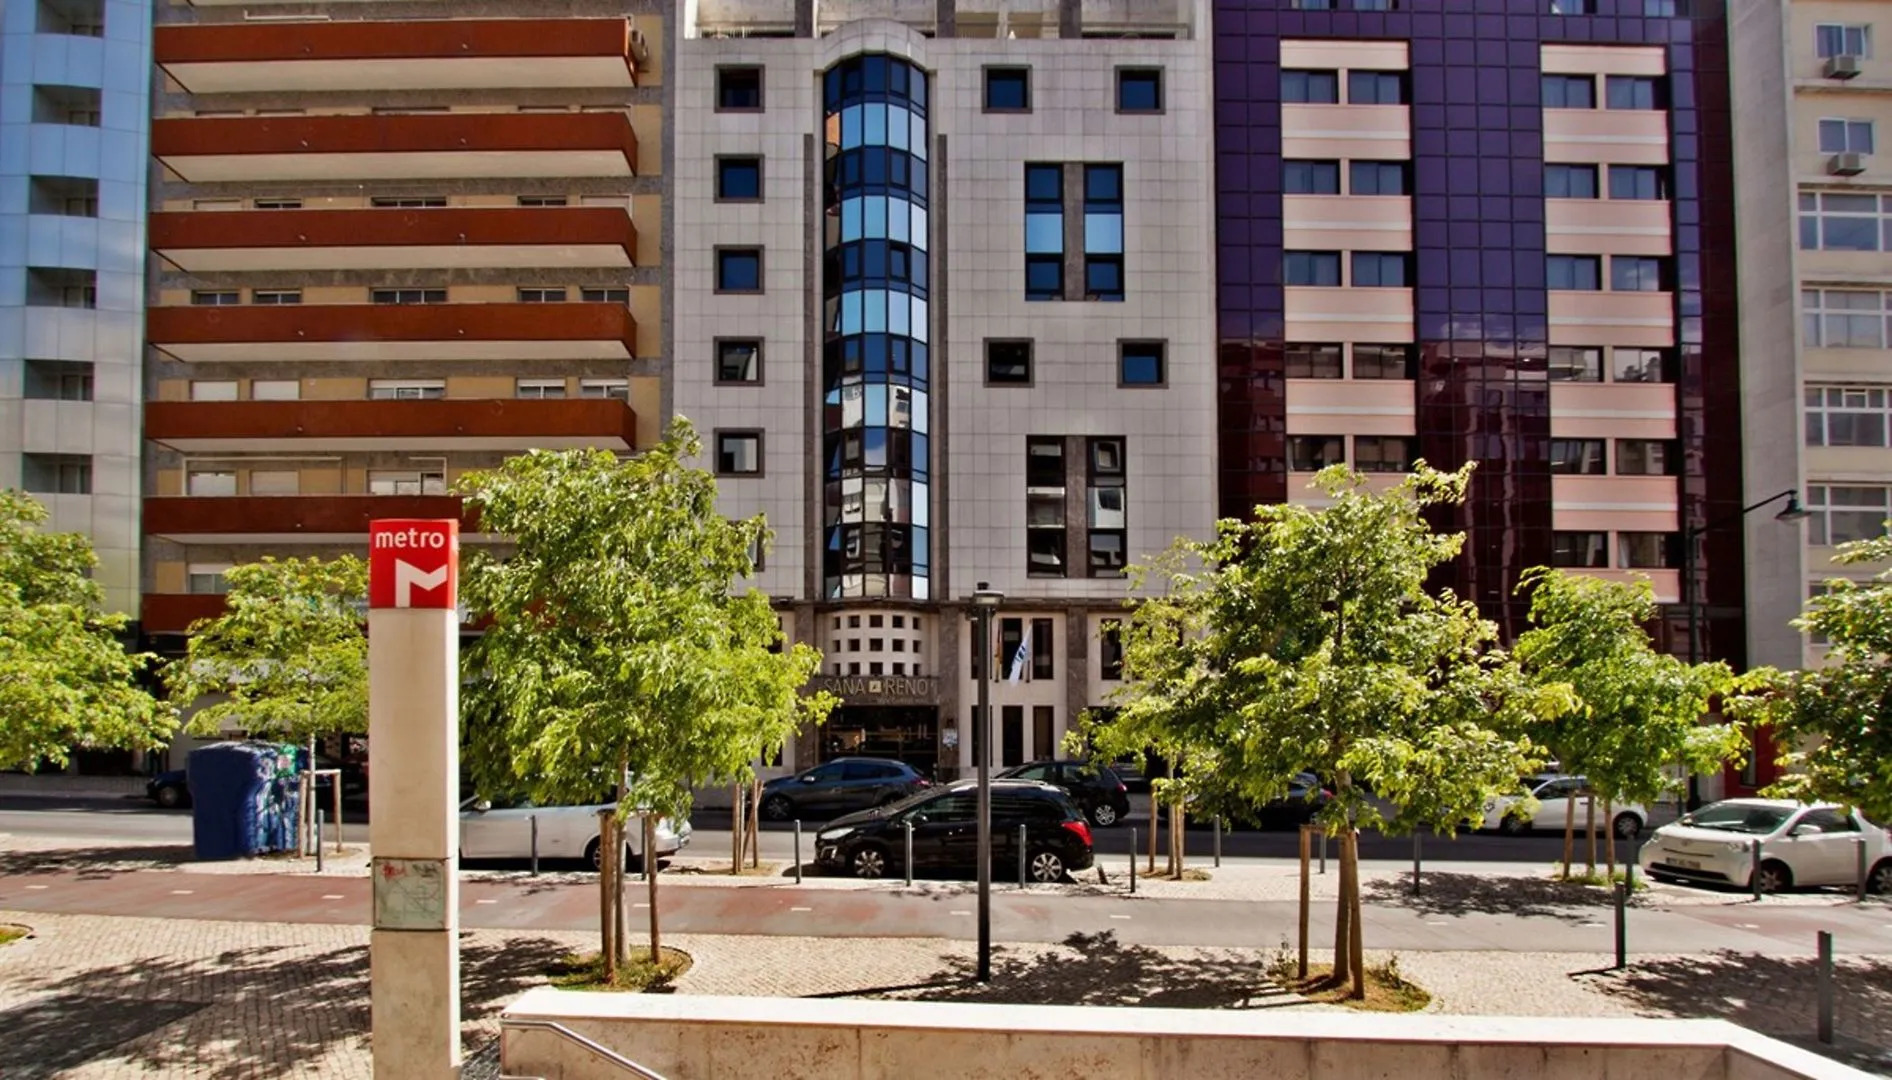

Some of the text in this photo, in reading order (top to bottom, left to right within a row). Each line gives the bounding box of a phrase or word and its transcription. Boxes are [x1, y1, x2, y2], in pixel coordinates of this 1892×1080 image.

[375, 527, 445, 548] metro
[824, 678, 928, 695] SANA RENO
